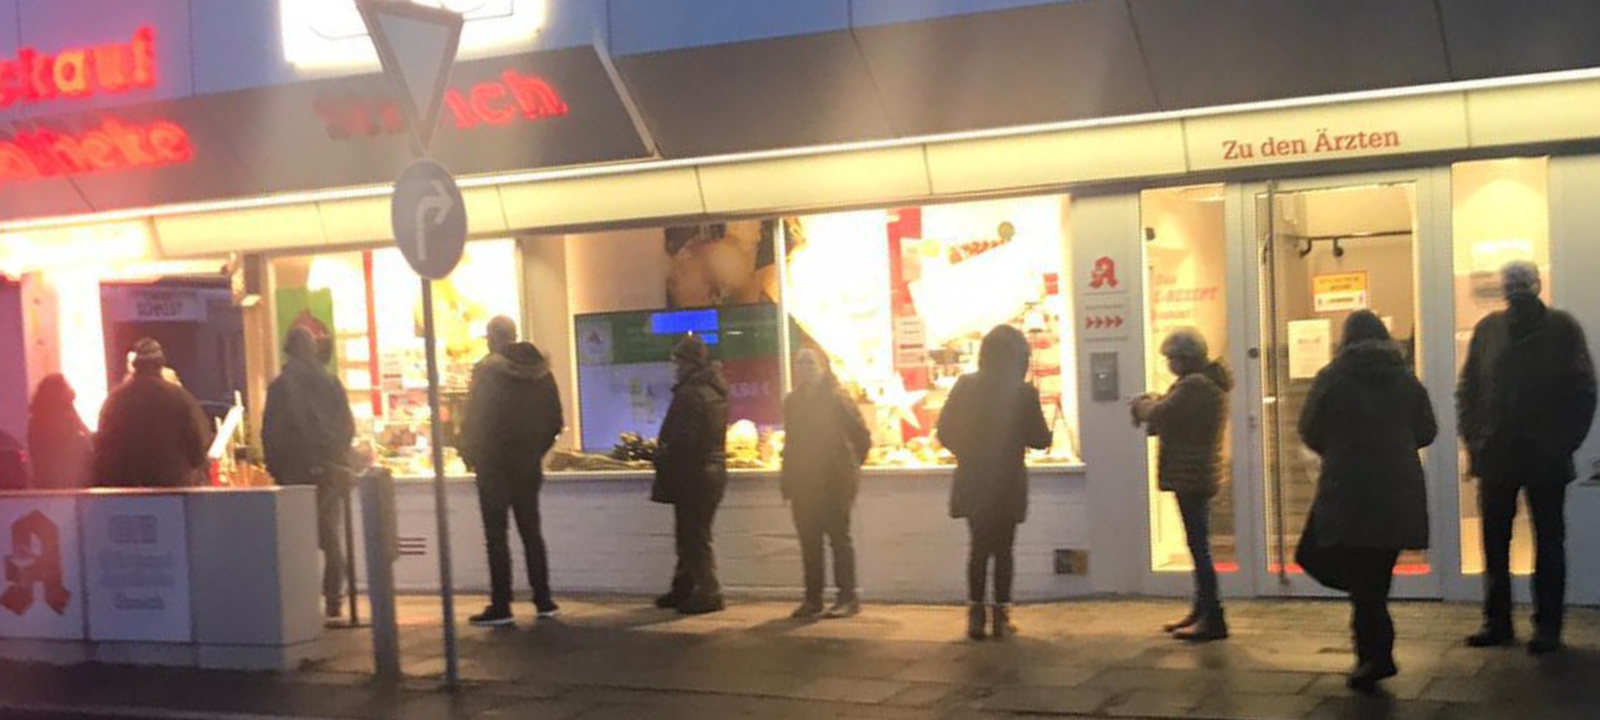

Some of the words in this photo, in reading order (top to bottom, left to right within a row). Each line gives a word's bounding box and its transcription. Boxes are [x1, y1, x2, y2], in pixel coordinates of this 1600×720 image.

[1223, 140, 1253, 160] Zu
[1261, 137, 1306, 157] den
[1314, 128, 1400, 153] Ärzten
